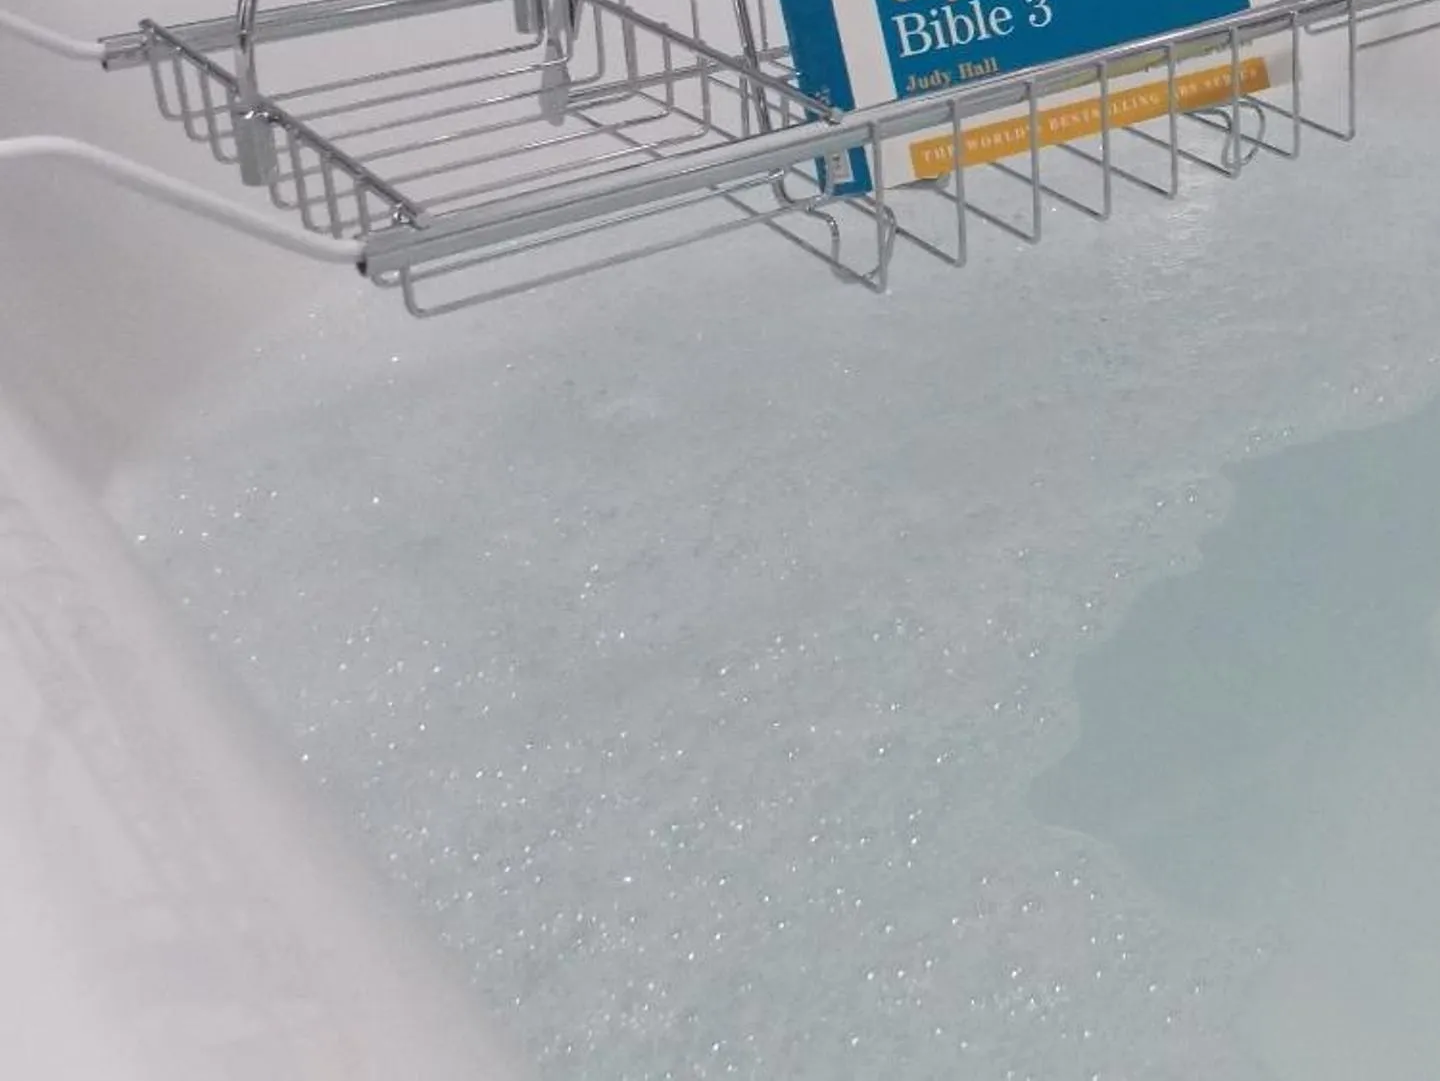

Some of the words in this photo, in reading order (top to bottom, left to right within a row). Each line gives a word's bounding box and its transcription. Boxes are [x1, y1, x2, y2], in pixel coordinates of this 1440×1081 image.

[891, 0, 1015, 58] Bible
[906, 70, 951, 92] Judy
[957, 57, 999, 80] Hall
[964, 124, 1040, 151] WORLD'
[1048, 92, 1160, 132] BESTSLLING
